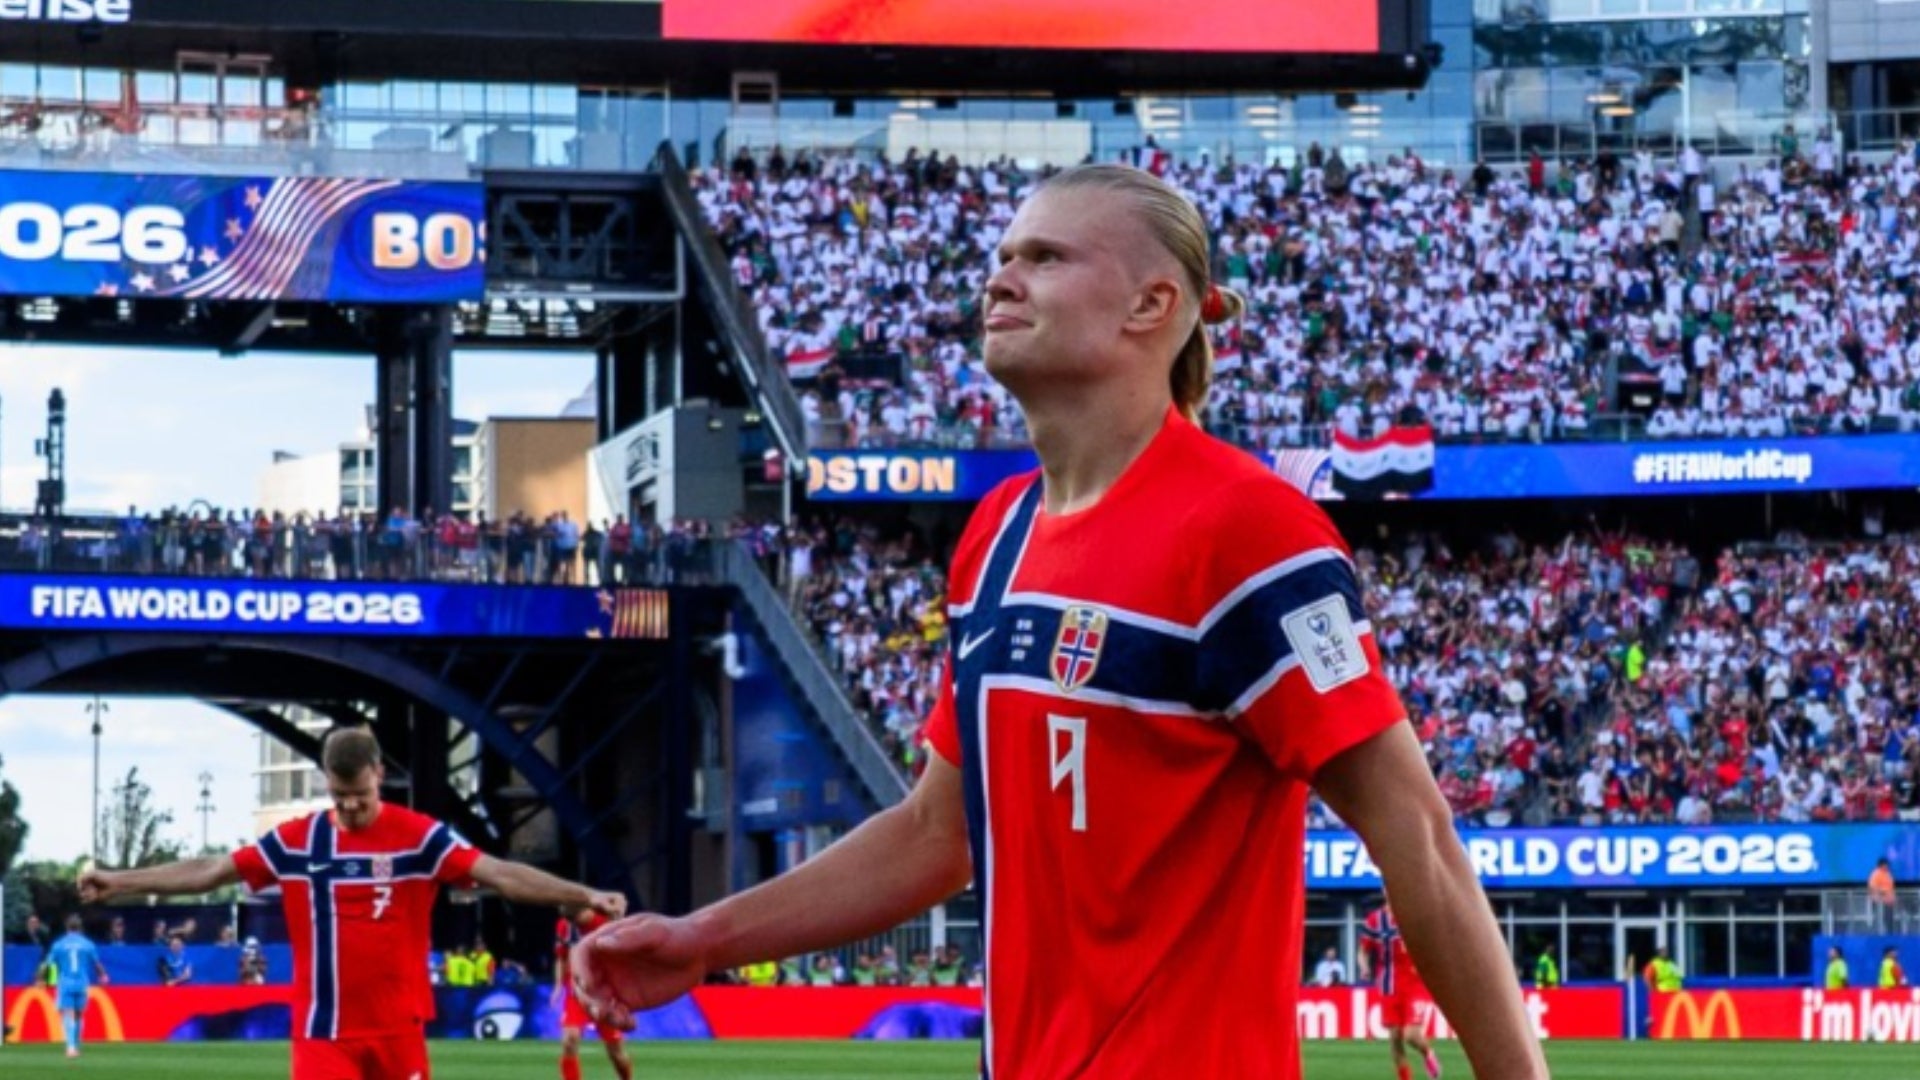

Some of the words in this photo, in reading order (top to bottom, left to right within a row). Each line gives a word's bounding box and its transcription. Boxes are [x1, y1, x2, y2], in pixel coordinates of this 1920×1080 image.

[373, 211, 485, 270] BO
[1634, 450, 1812, 483] #FIFAWorldCup
[32, 586, 105, 618] FIFA
[108, 587, 231, 620] WORLD
[235, 590, 302, 621] CUP
[305, 592, 421, 624] 2026
[1046, 712, 1087, 832] 9
[1566, 836, 1660, 875] CUP
[1666, 834, 1814, 875] 2026
[371, 885, 393, 920] 7
[1802, 987, 1855, 1041] i'm
